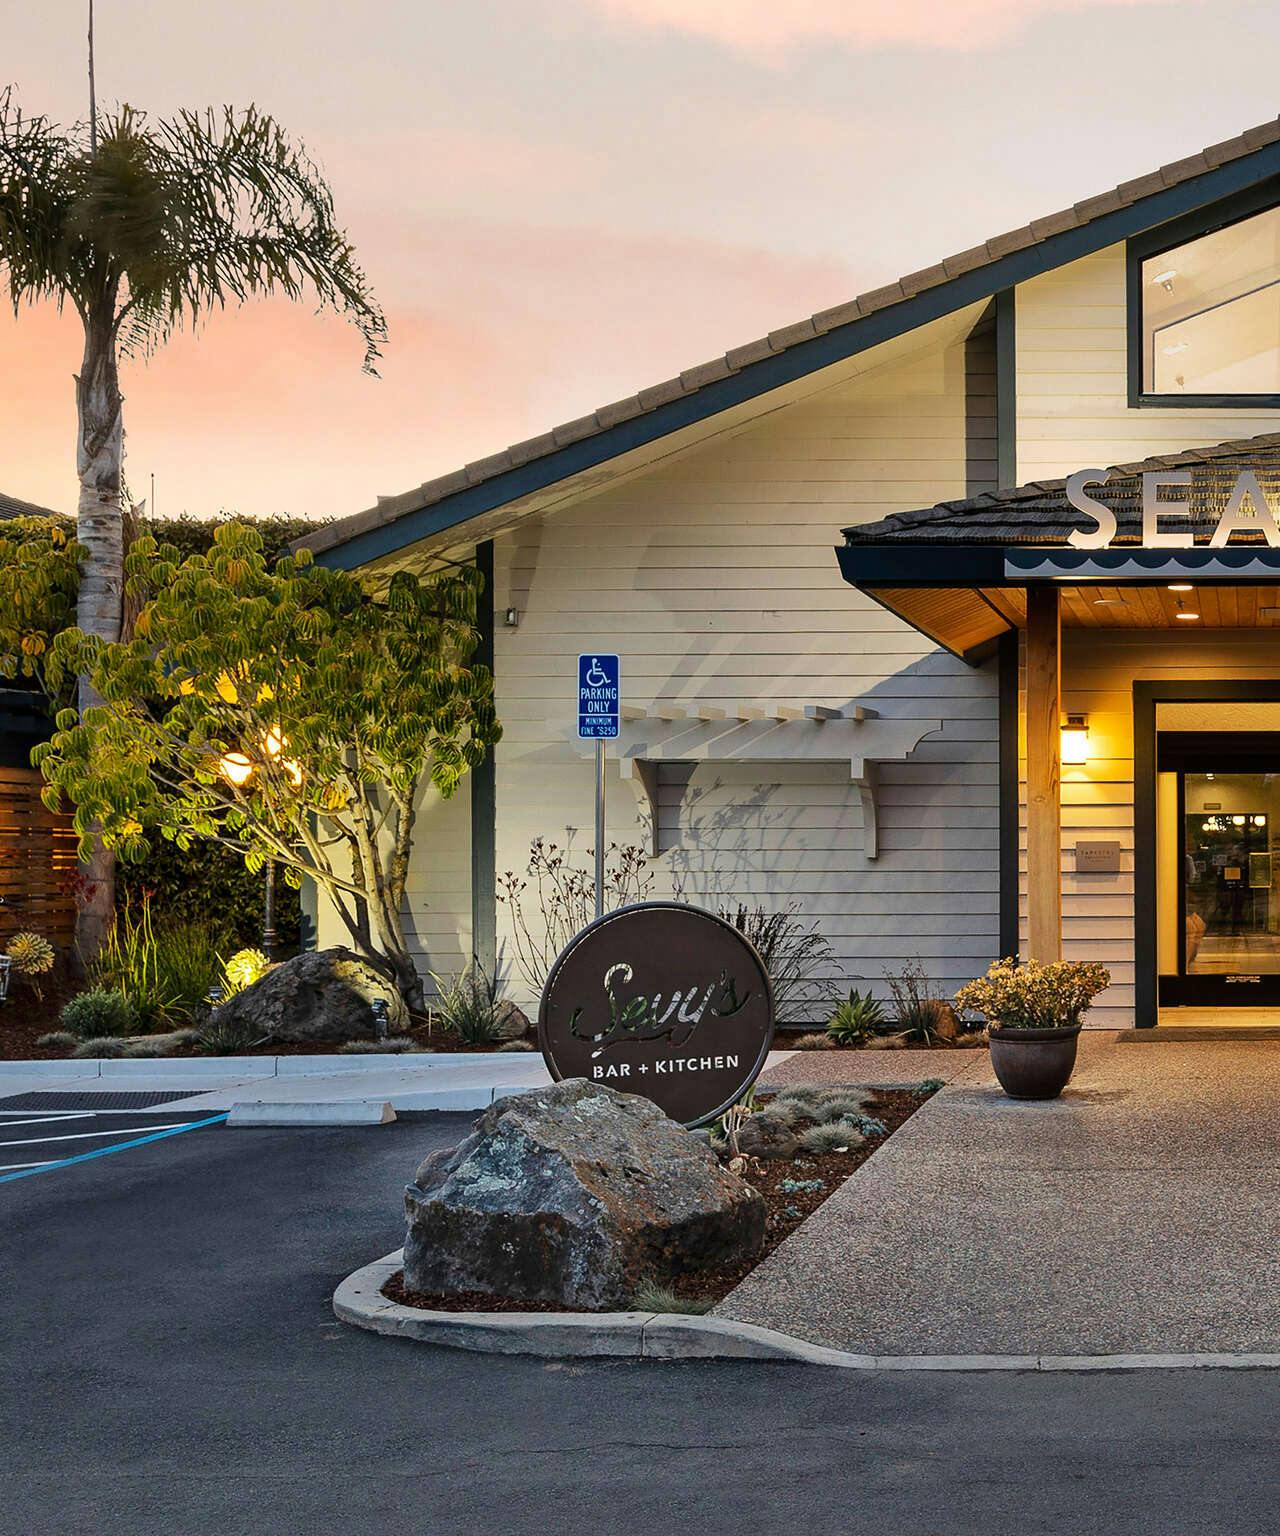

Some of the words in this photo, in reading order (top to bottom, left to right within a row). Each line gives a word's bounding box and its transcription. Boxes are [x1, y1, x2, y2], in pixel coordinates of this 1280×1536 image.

[581, 688, 617, 700] PARKING
[587, 701, 610, 713] ONLY
[585, 717, 612, 726] MINIMUM
[581, 726, 594, 736] FINE
[593, 1063, 631, 1079] BAR
[638, 1064, 649, 1074] +
[655, 1055, 739, 1073] KITCHEN
